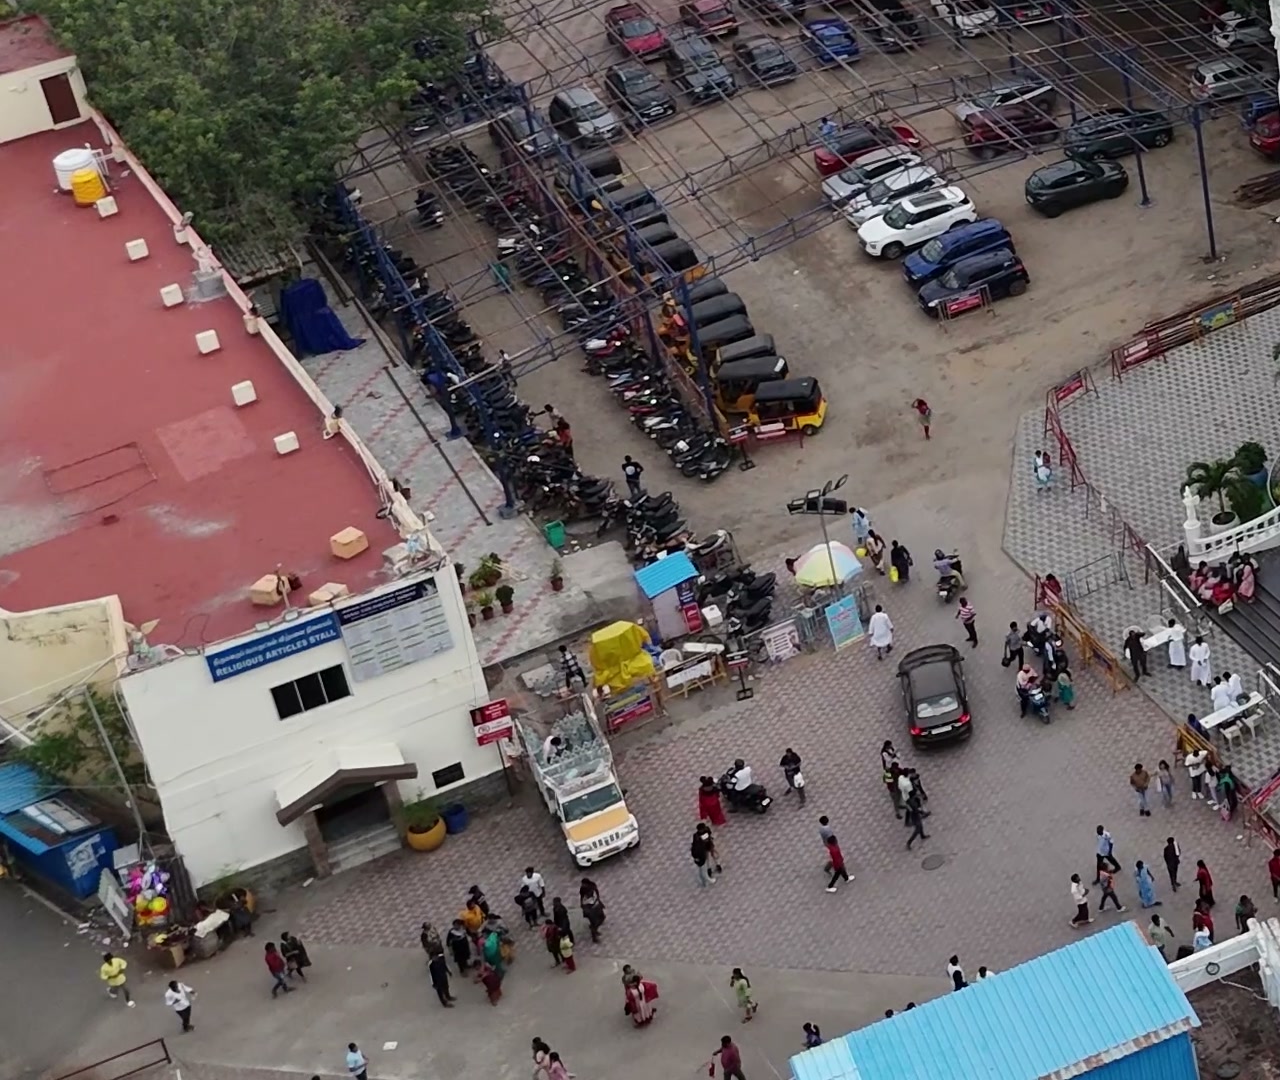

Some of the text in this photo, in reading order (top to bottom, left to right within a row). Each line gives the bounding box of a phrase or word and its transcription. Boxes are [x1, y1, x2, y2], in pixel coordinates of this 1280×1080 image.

[216, 654, 264, 677] RELIGIOUS
[266, 639, 308, 659] ARTICLES
[308, 629, 337, 644] STALL
